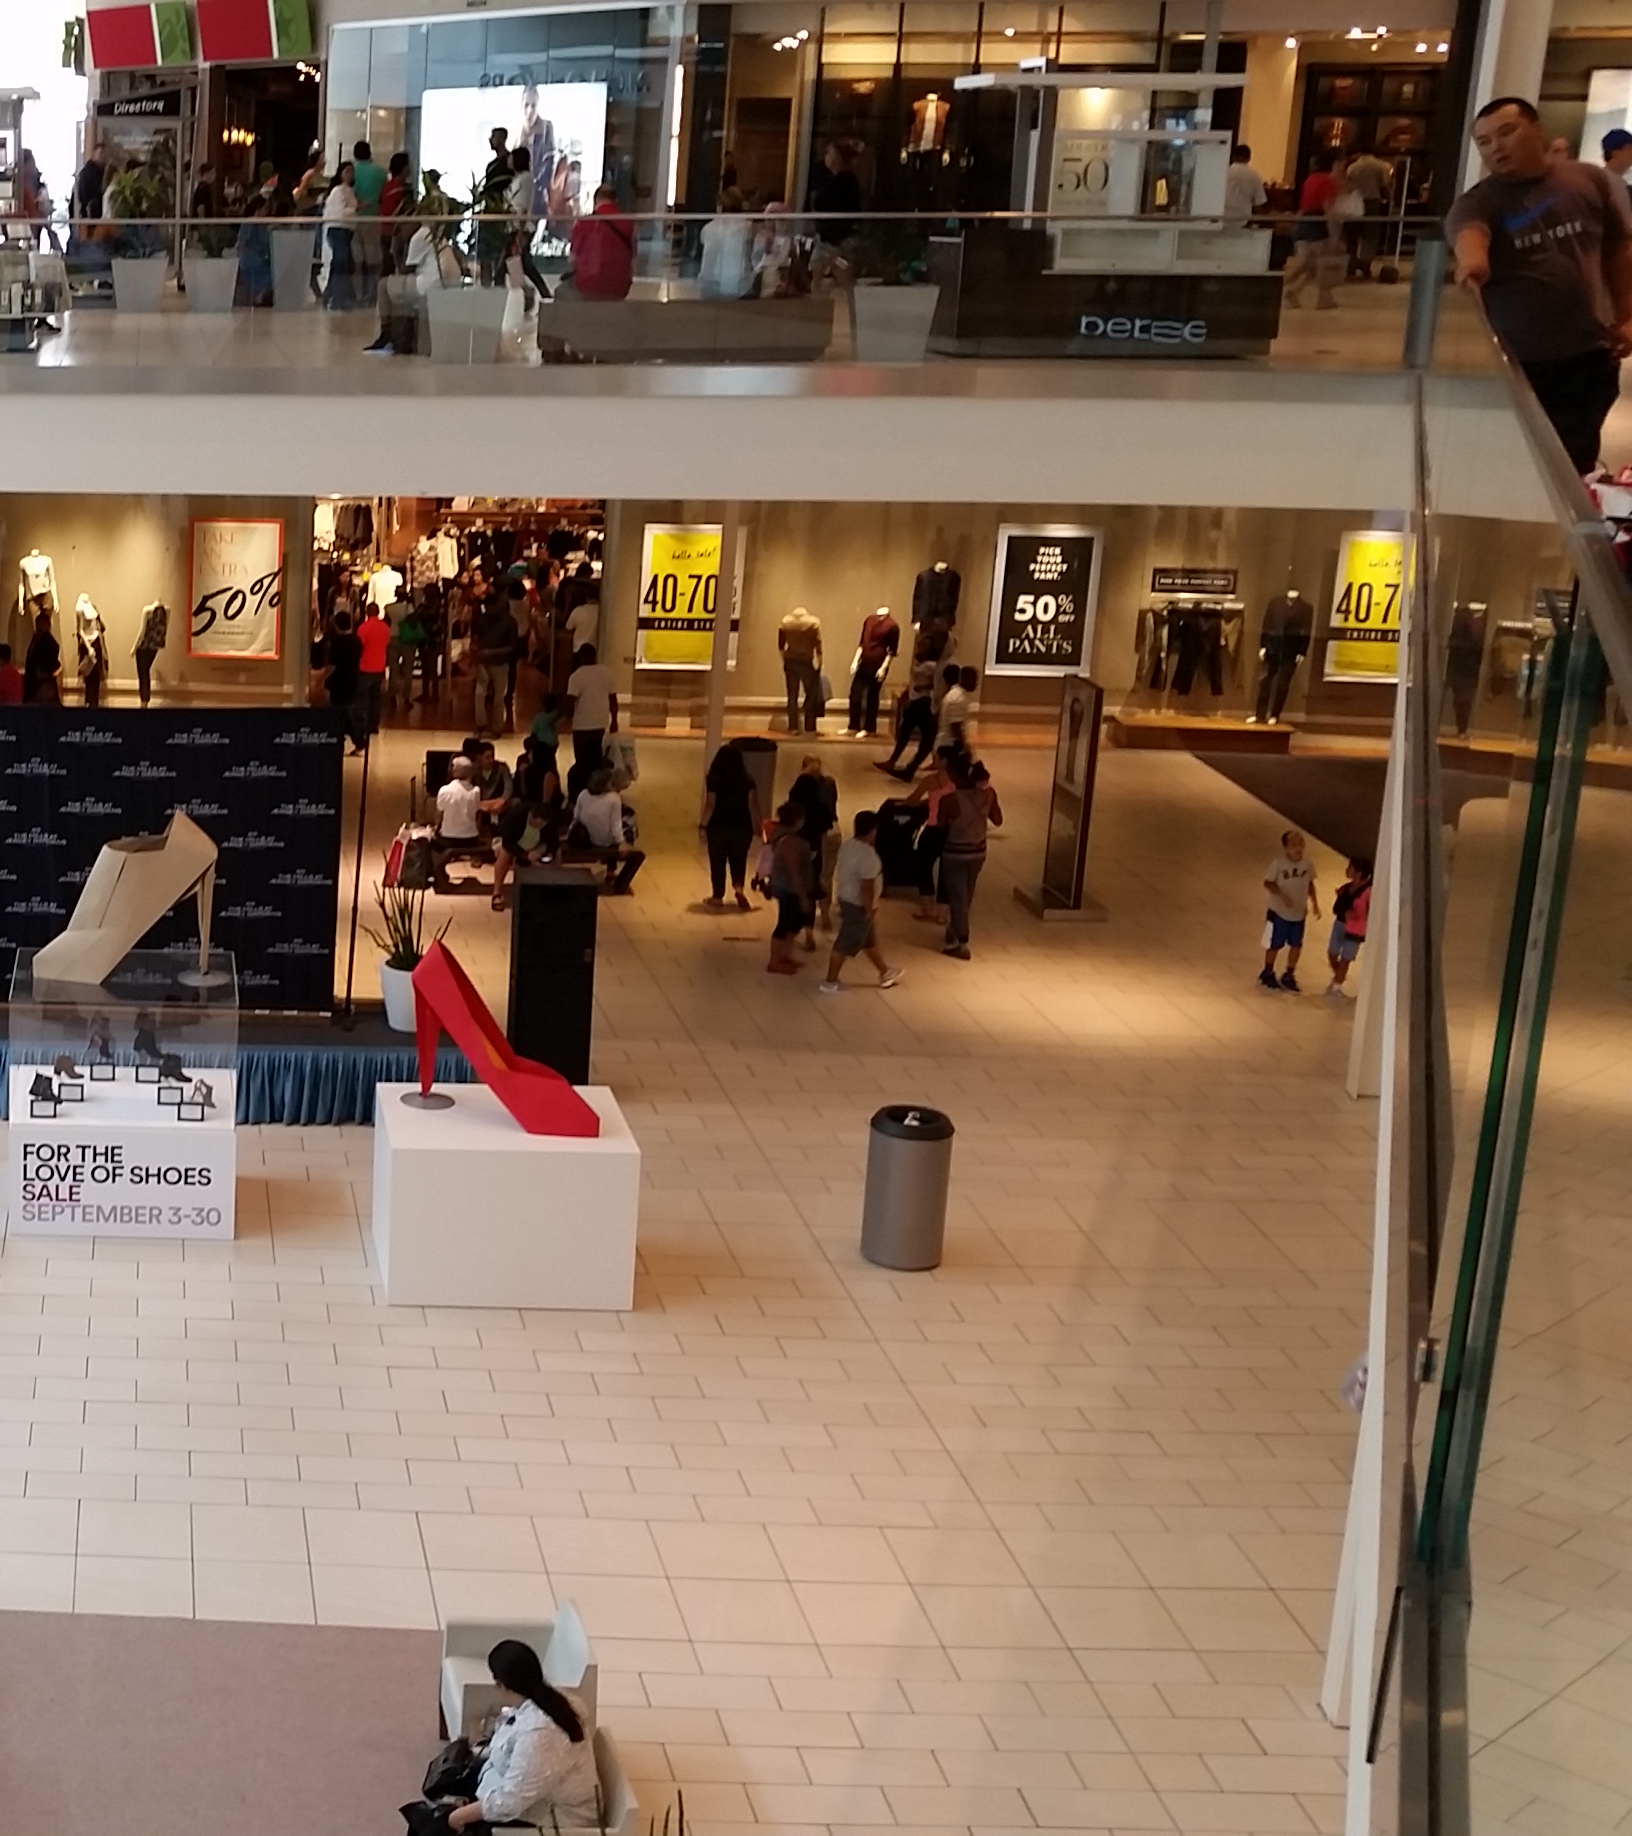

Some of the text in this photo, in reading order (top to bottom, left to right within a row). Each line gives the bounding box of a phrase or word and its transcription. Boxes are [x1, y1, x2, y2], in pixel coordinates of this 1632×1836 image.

[114, 99, 165, 116] Directory
[1057, 157, 1110, 194] 50
[190, 566, 282, 637] 50%
[643, 573, 718, 614] 40-70
[1335, 581, 1402, 624] 40-7
[1013, 593, 1075, 622] 50%
[1021, 624, 1061, 639] ALL
[1008, 638, 1073, 655] PANTS
[22, 1143, 124, 1164] FOR THE
[22, 1164, 212, 1187] LOVE OF SHOES
[21, 1183, 82, 1203] SALE
[21, 1203, 222, 1227] SEPTEMBER 3-30
